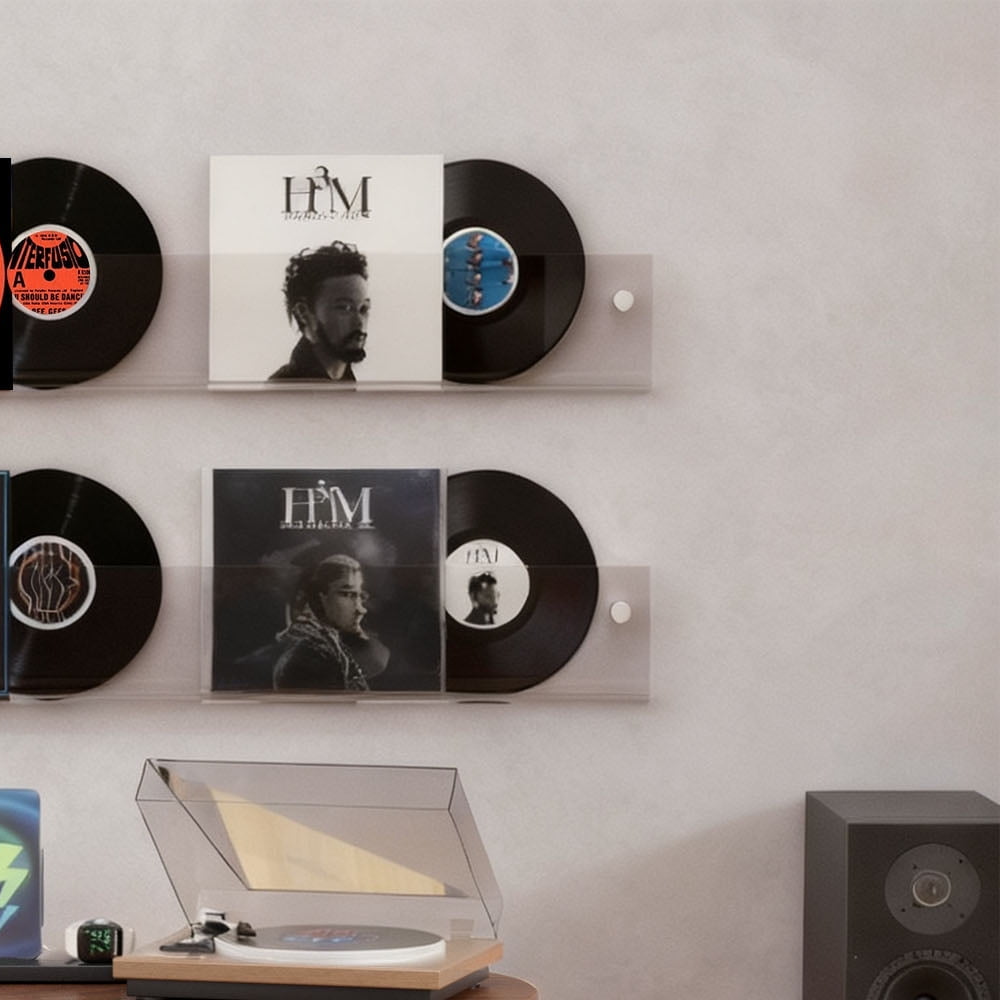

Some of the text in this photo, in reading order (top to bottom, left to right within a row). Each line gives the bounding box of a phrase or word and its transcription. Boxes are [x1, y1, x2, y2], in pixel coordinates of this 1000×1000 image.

[13, 271, 26, 288] A
[21, 293, 49, 301] SHOULD
[50, 293, 60, 301] BE
